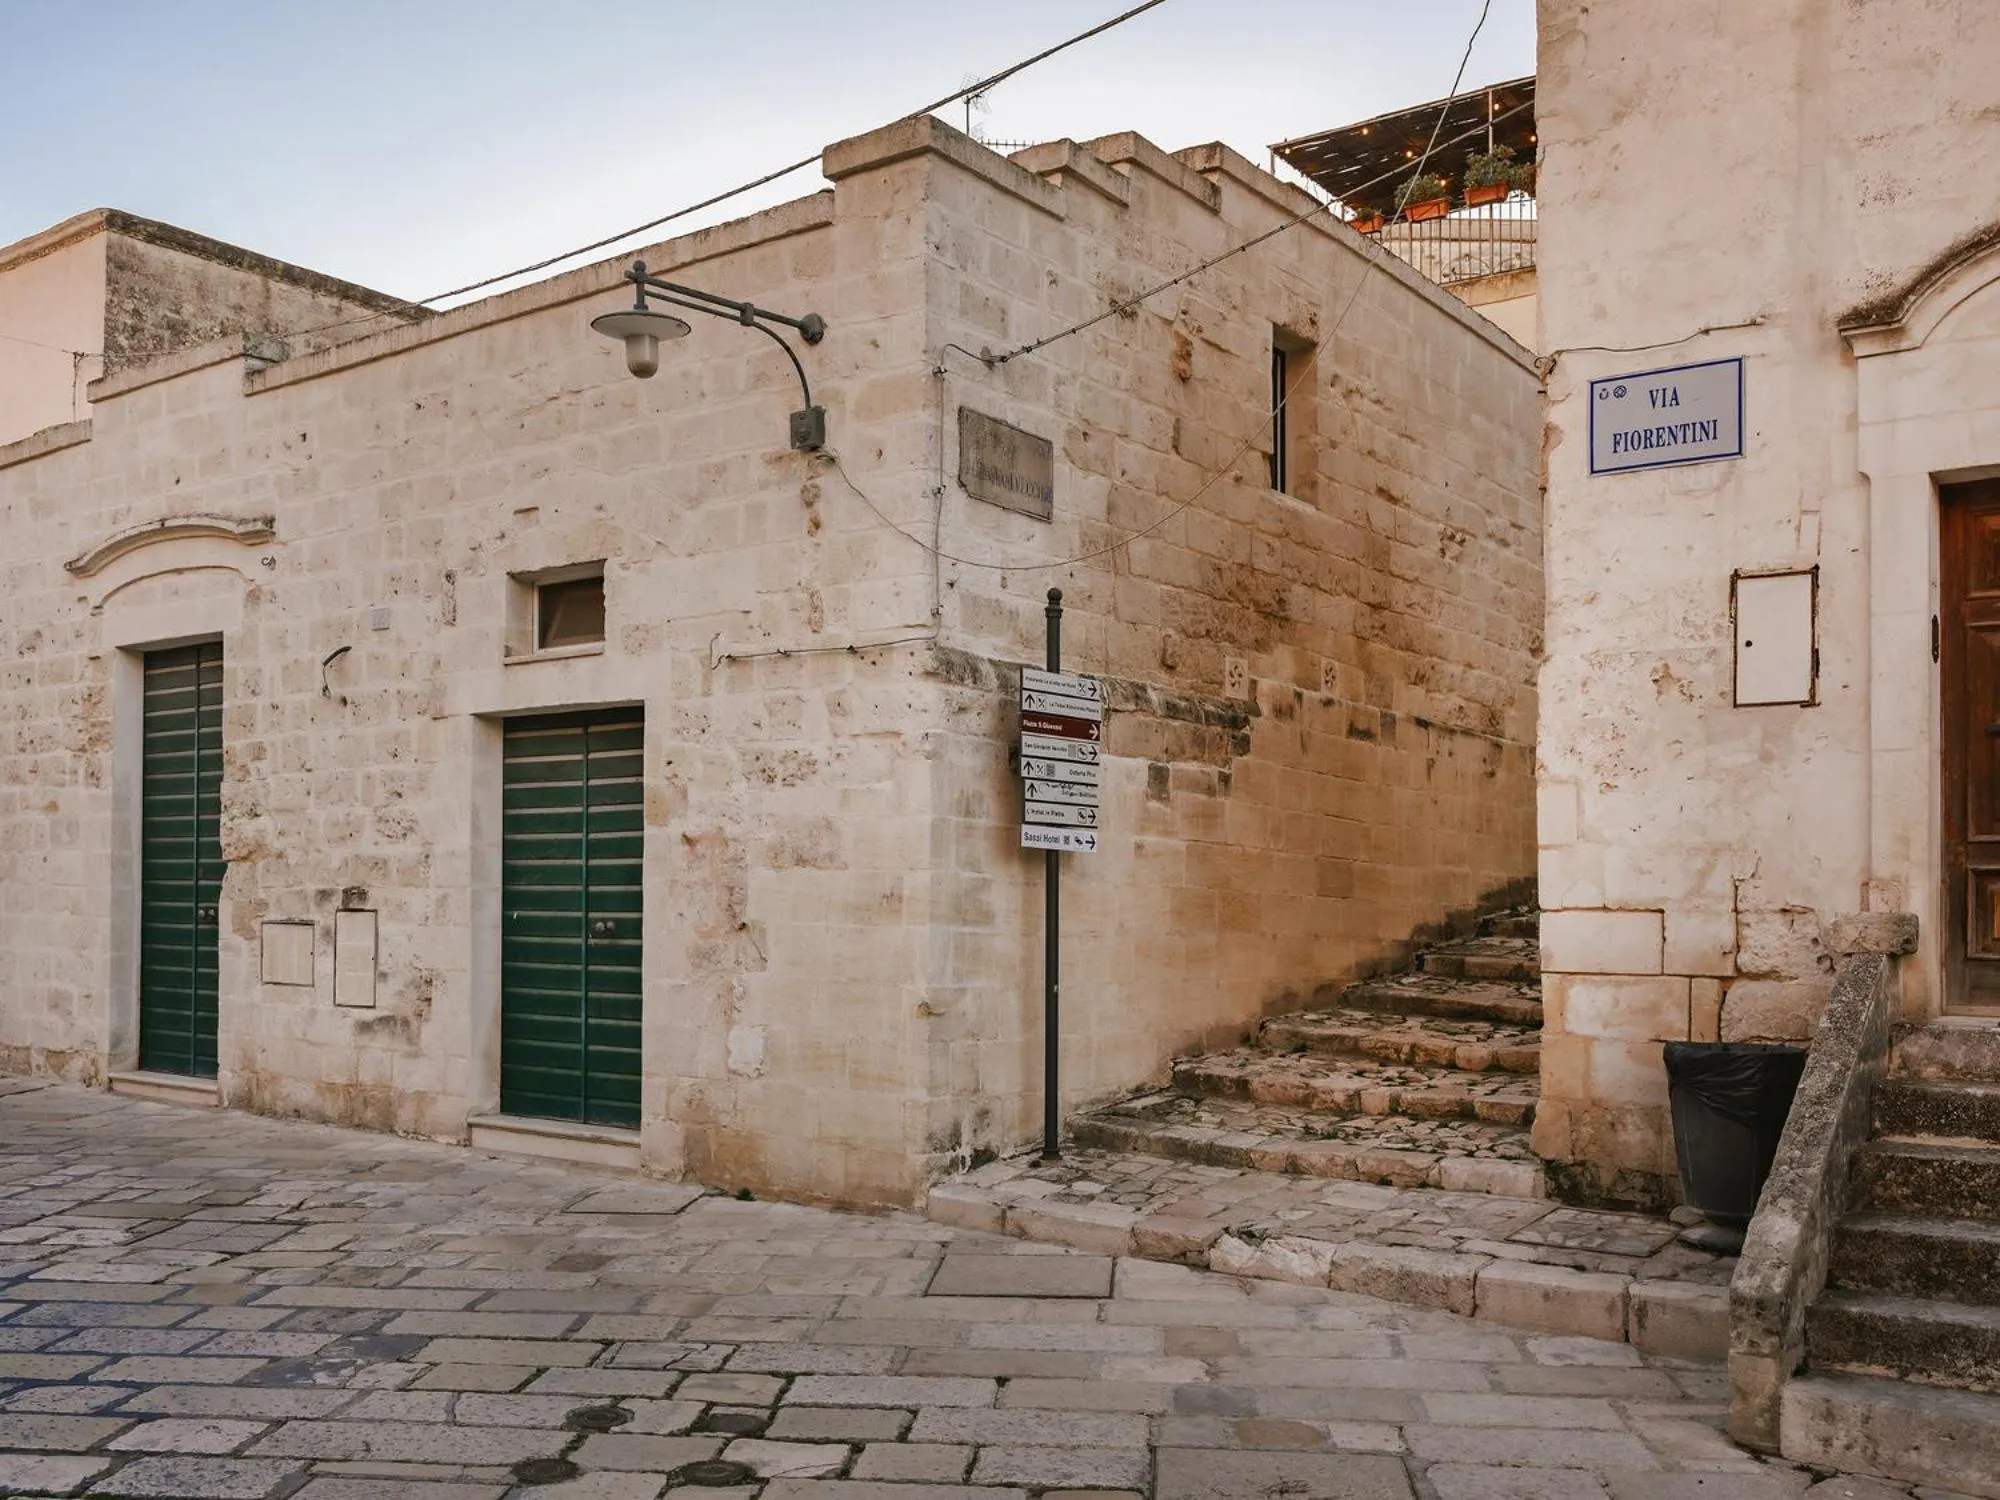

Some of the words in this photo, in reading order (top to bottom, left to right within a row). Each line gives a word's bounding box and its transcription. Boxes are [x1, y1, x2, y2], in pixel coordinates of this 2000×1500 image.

[1649, 387, 1680, 409] VIA
[1612, 419, 1718, 454] FIORENTINI
[1024, 831, 1042, 841] Sassi
[1043, 833, 1060, 843] Hotel
